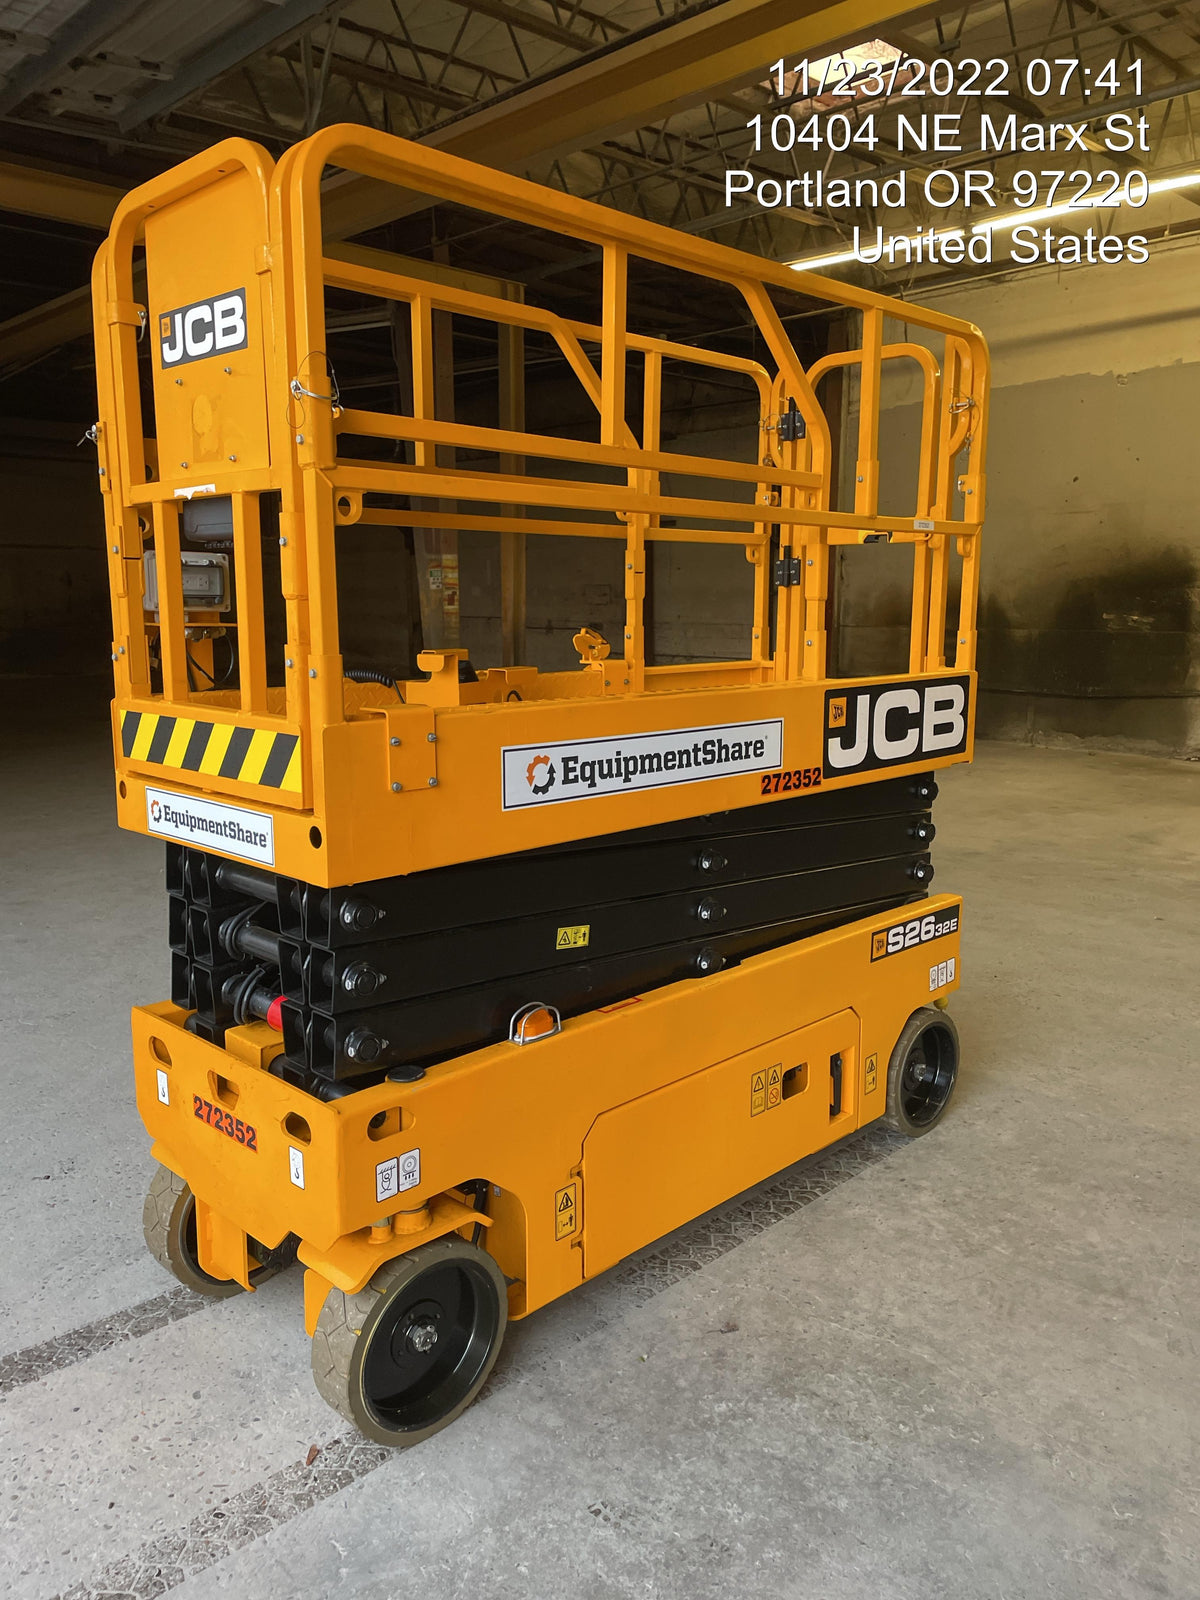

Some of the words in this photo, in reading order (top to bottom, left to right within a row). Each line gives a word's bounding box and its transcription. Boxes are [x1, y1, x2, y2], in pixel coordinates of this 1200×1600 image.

[162, 295, 245, 363] JCB
[828, 684, 965, 769] JCB
[561, 737, 766, 788] EquipmentShare
[761, 767, 821, 795] 272352
[163, 805, 268, 848] EquipmentShare
[193, 1096, 258, 1151] 272352
